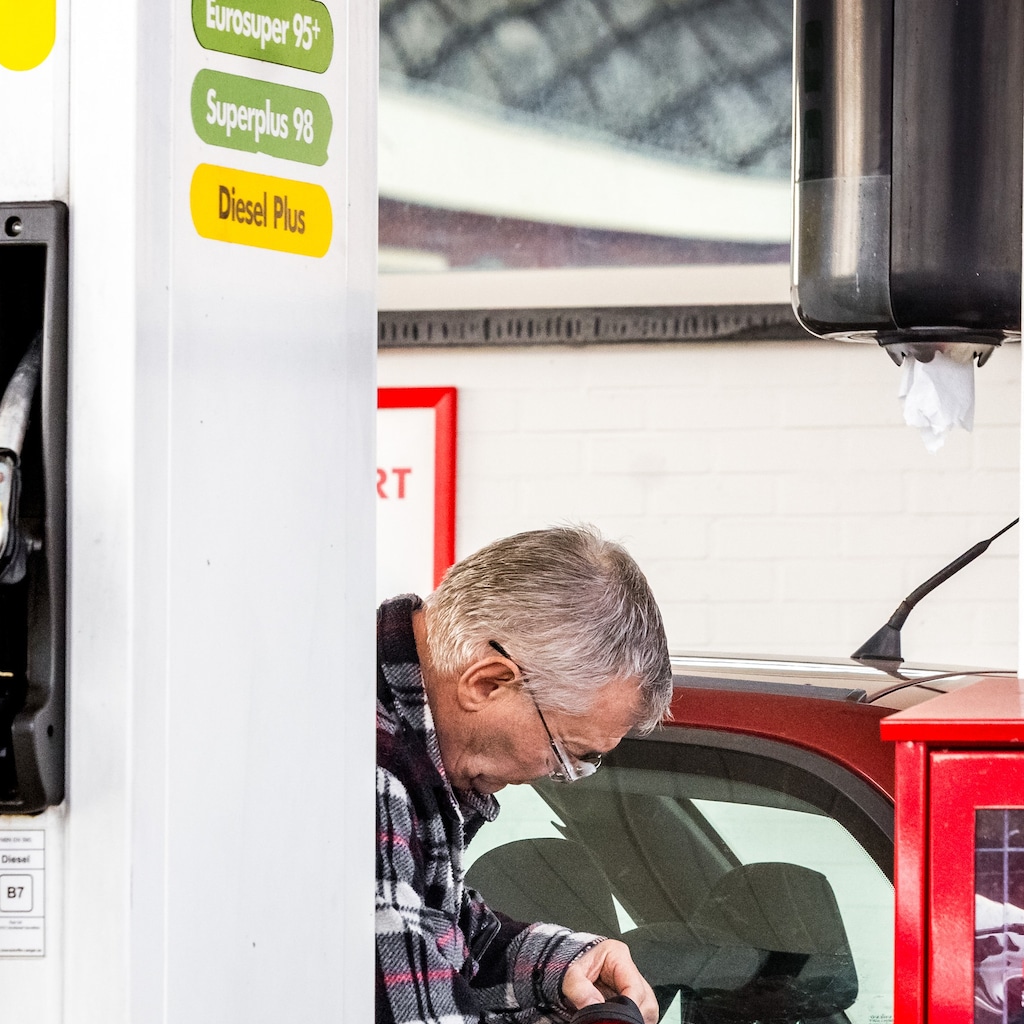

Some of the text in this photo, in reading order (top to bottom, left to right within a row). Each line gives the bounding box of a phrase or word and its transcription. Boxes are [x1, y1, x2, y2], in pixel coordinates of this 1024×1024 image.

[206, 0, 289, 49] Eurosuper
[206, 88, 314, 144] Superplus 98
[219, 185, 305, 234] Diesel Plus
[1, 855, 30, 863] Diesel
[7, 887, 24, 899] B7
